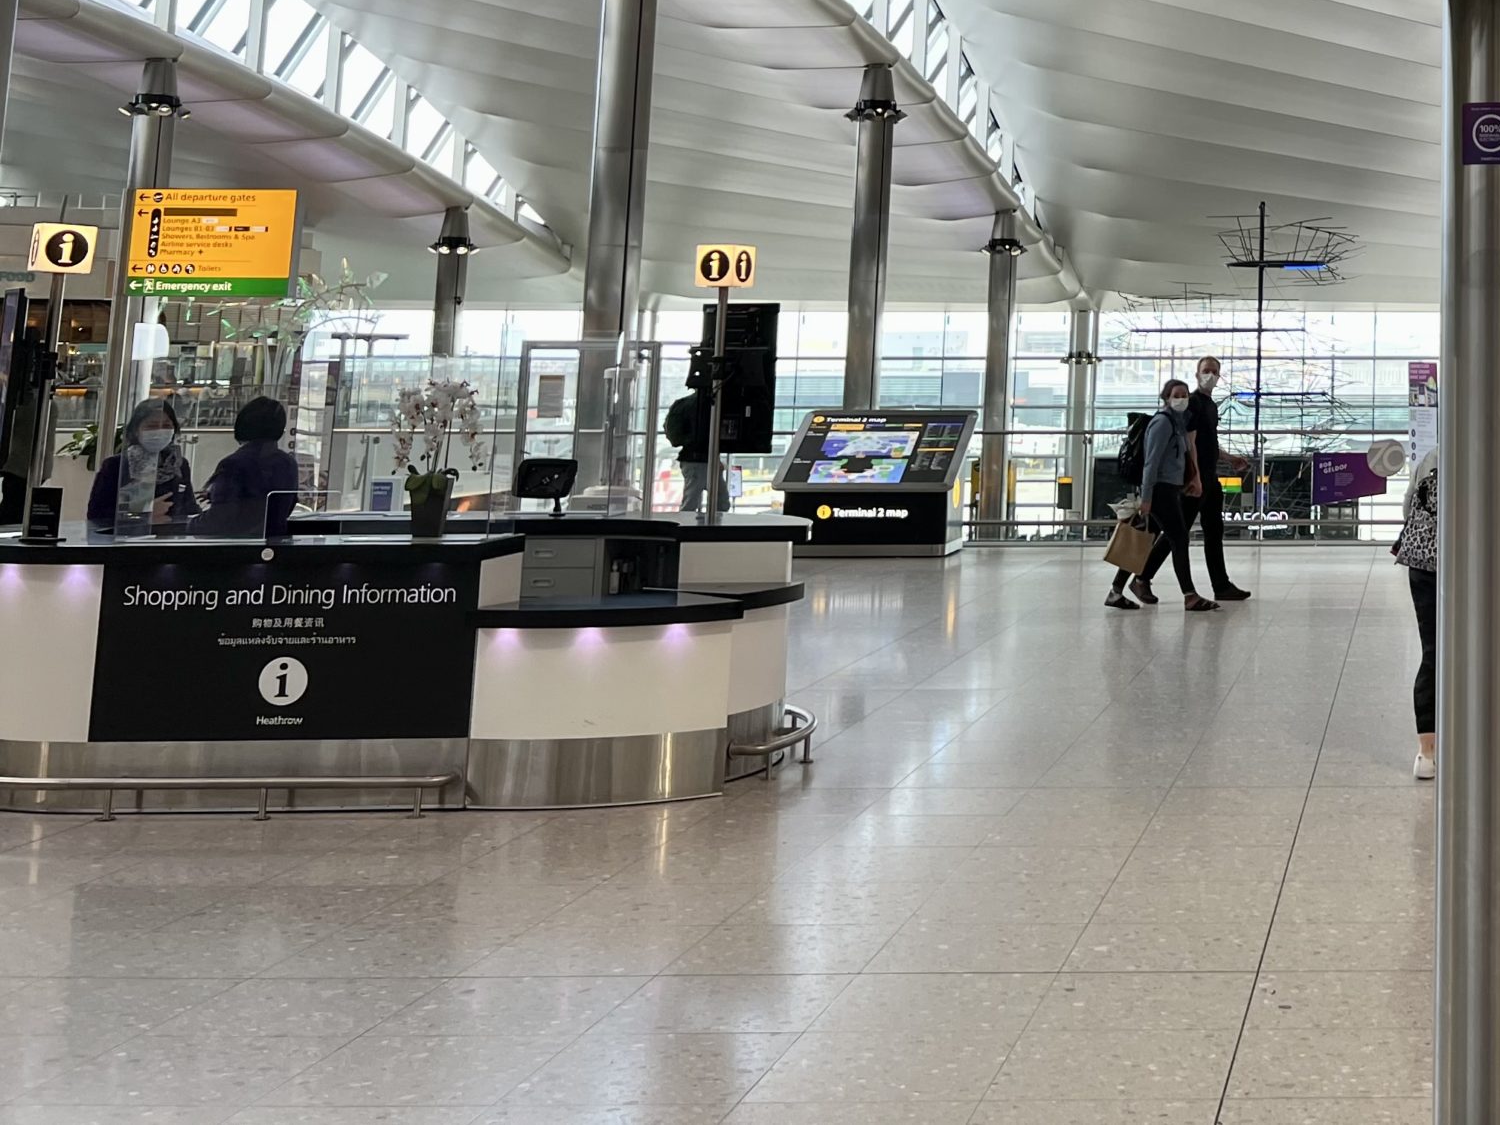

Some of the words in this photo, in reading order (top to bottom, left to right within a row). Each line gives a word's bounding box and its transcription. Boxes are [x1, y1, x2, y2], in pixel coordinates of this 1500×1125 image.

[180, 193, 228, 203] departure
[230, 194, 256, 203] gates
[156, 281, 211, 292] Emergency
[212, 281, 232, 291] exit
[1319, 461, 1332, 469] BOB
[1323, 464, 1347, 474] GELDOF
[833, 507, 877, 517] Terminal
[877, 508, 884, 517] 2
[885, 509, 908, 518] map
[123, 585, 218, 610] Shopping
[225, 584, 264, 605] and
[271, 584, 335, 609] Dining
[343, 583, 456, 604] Information
[252, 617, 324, 628] 购物及用餐资讯
[256, 716, 303, 725] Heathrow
